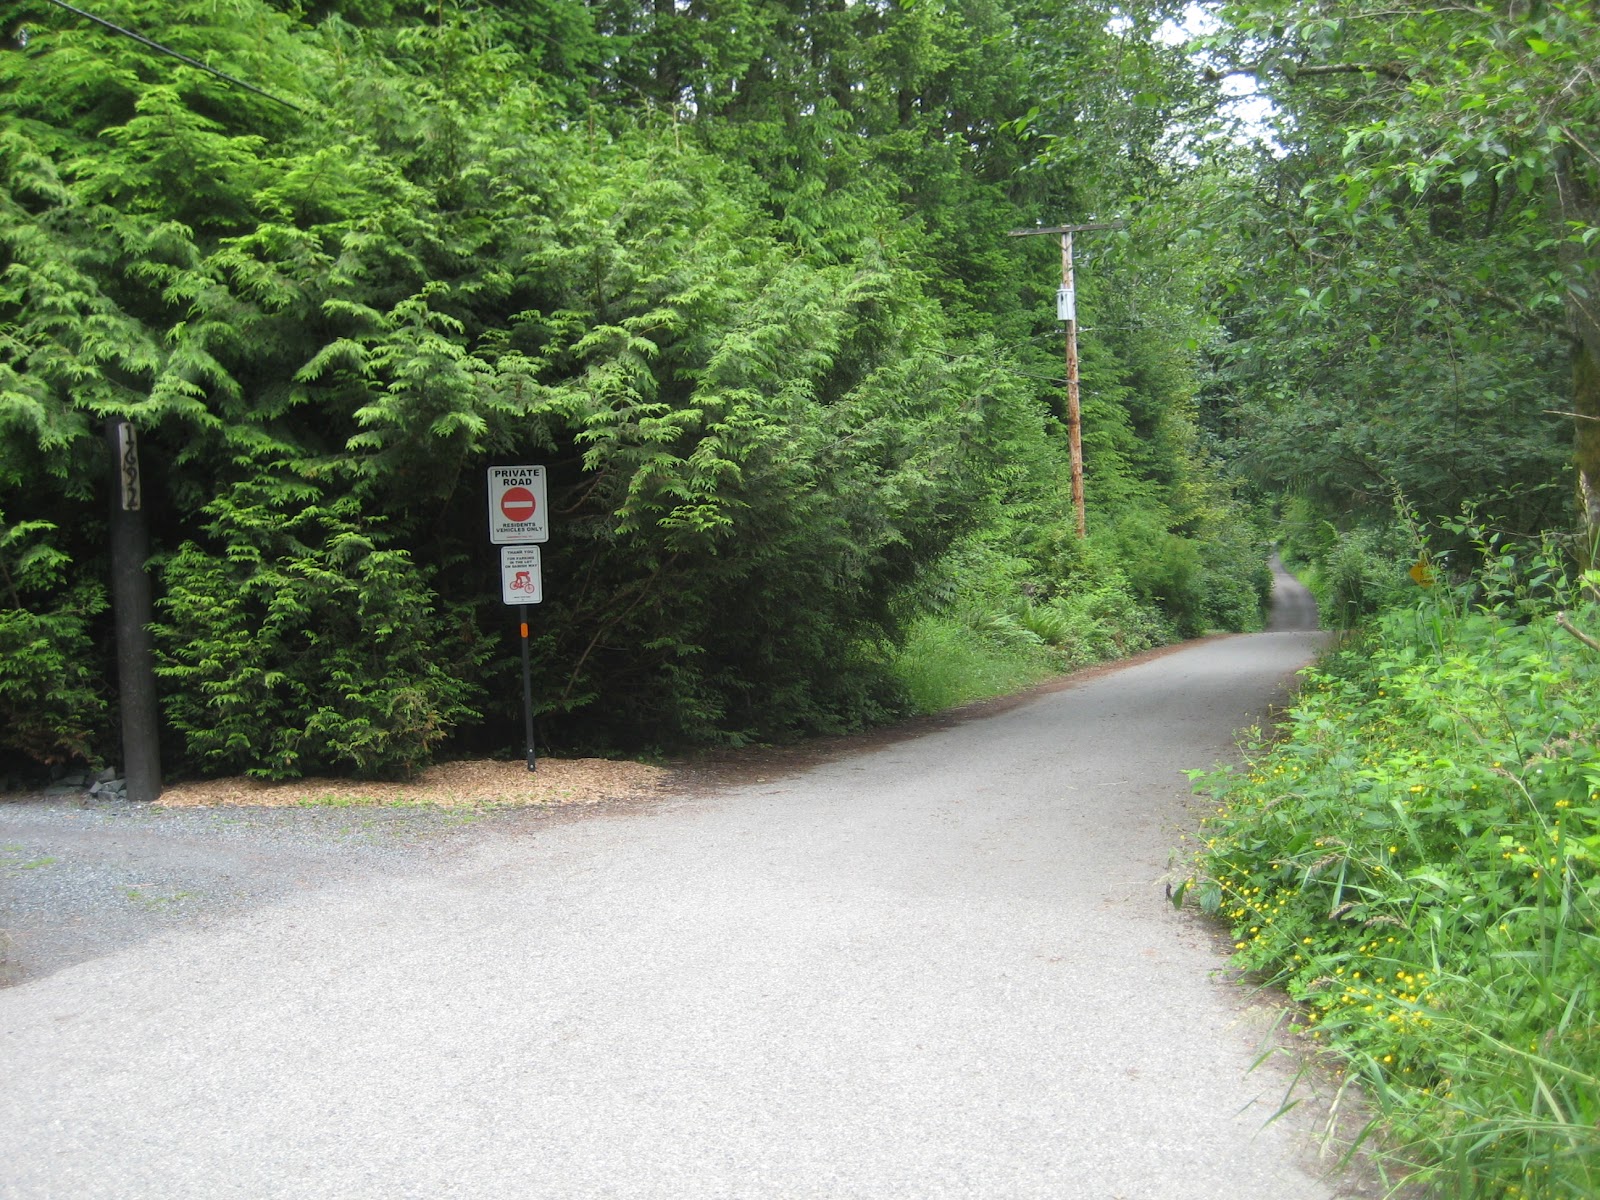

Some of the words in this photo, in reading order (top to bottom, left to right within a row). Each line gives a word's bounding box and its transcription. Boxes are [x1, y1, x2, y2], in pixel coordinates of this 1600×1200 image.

[124, 424, 138, 507] 1692
[494, 469, 540, 478] PRIVATE
[503, 478, 532, 486] ROAD
